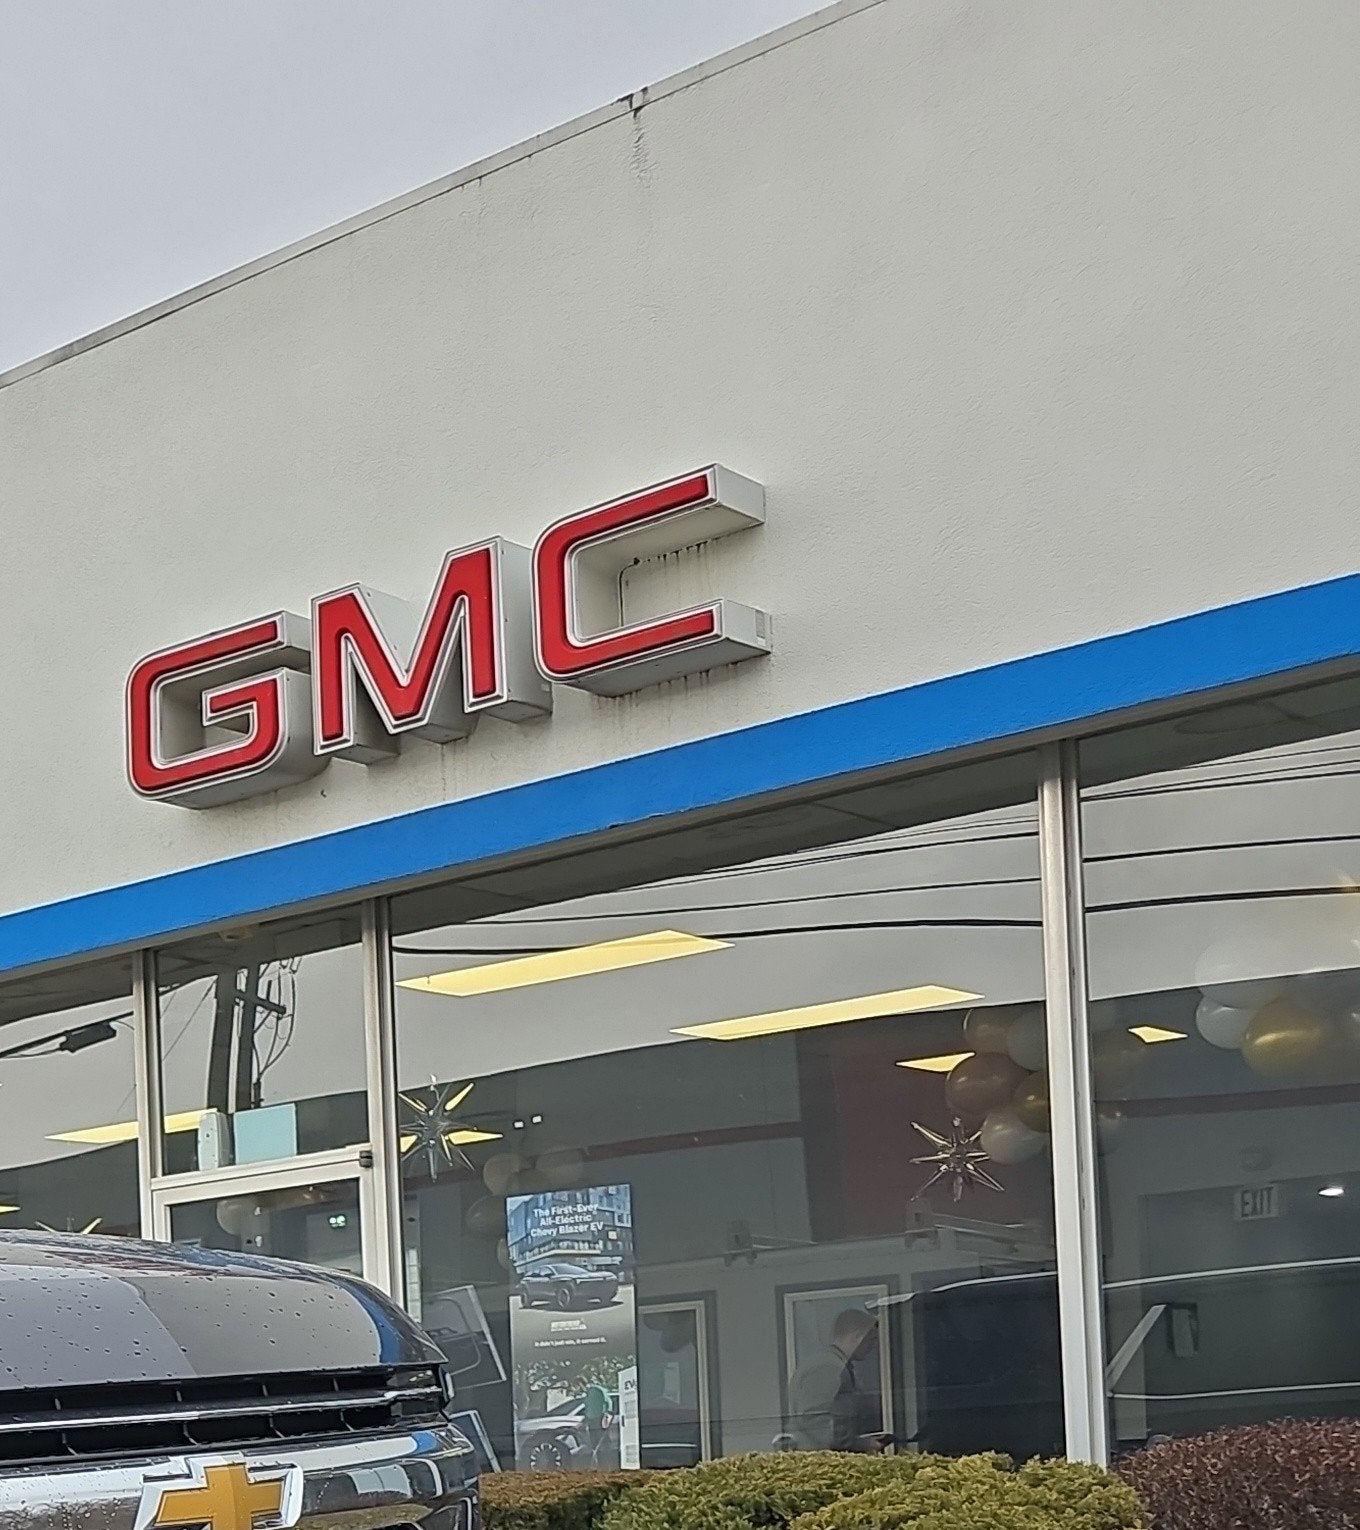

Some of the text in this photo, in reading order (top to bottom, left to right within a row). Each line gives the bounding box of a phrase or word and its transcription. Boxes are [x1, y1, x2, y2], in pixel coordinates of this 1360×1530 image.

[126, 463, 762, 806] GMC
[1241, 1187, 1274, 1217] EXIT
[533, 1204, 598, 1218] The First-Ever
[540, 1214, 592, 1226] All-Electric
[530, 1221, 604, 1237] Chevy Blazer EV
